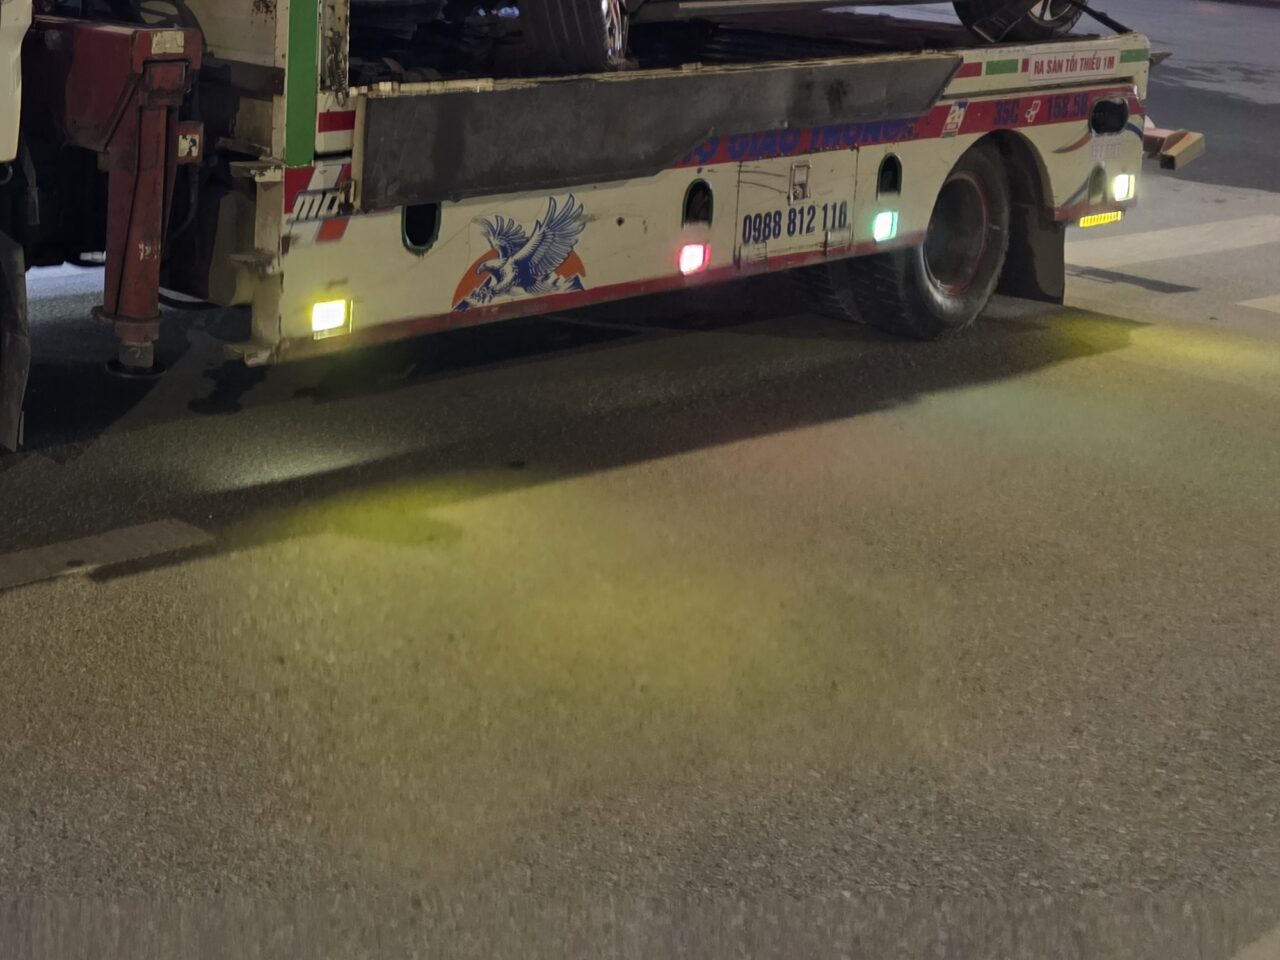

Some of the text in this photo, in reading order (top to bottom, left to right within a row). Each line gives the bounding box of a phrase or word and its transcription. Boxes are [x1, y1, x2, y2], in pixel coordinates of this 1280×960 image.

[1033, 60, 1044, 75] RA
[1103, 55, 1115, 70] 1M
[742, 209, 783, 245] 0988
[787, 204, 816, 239] 812
